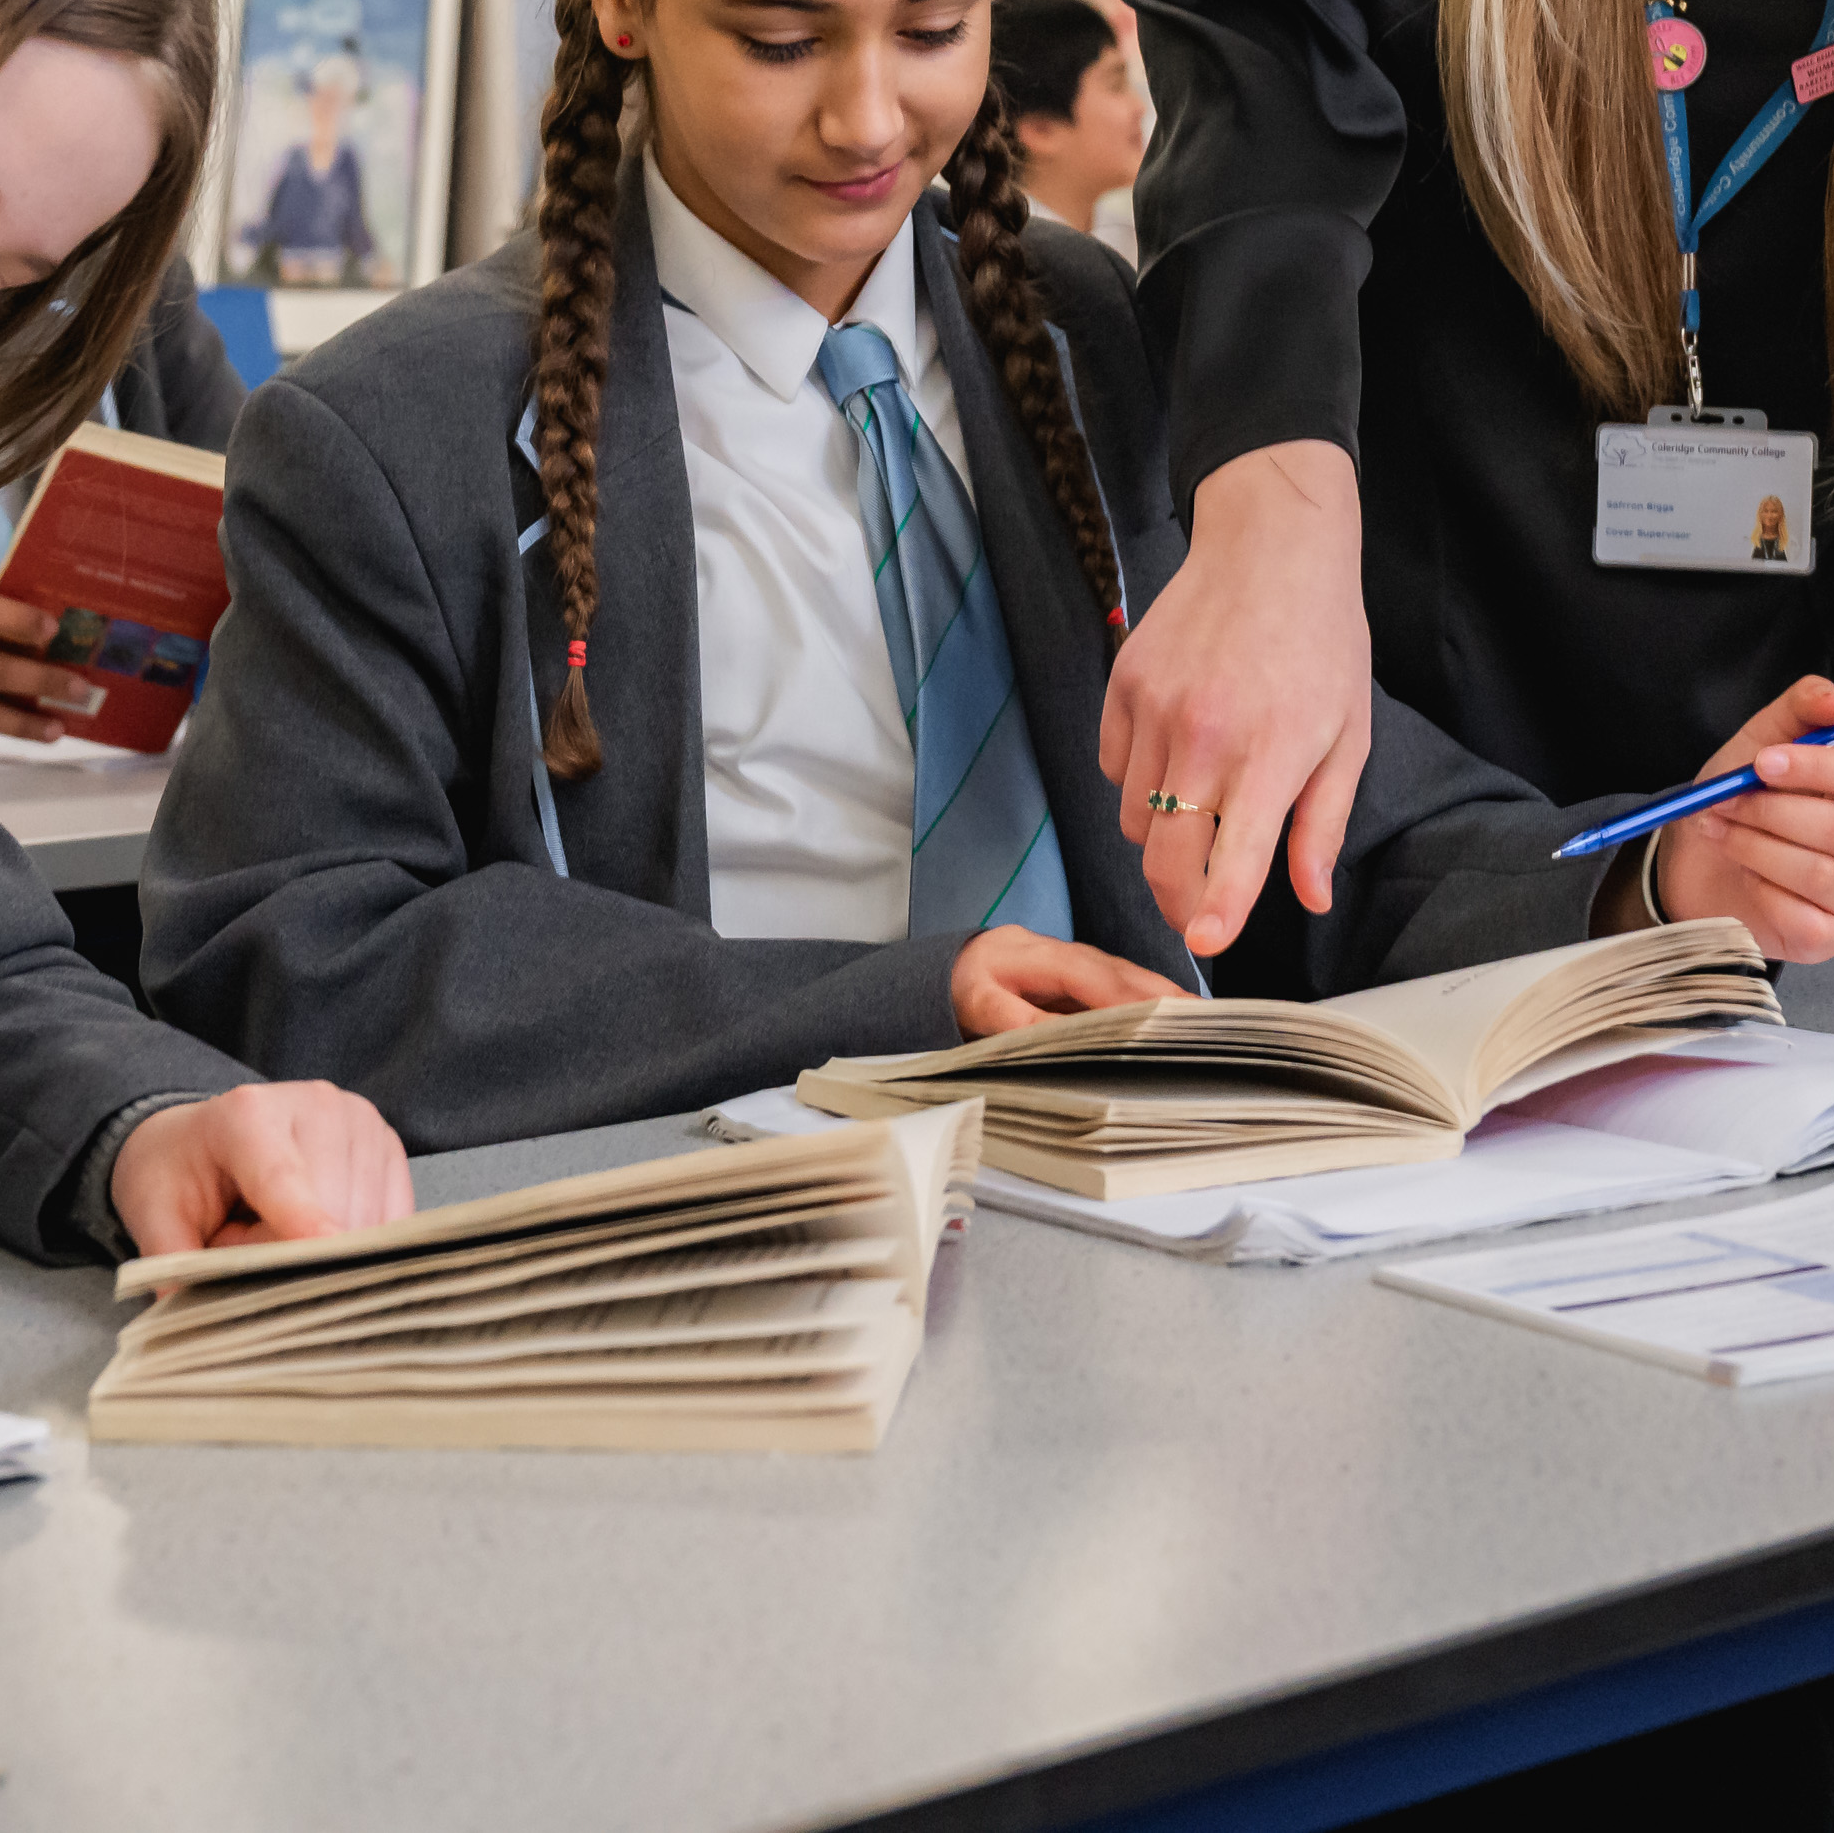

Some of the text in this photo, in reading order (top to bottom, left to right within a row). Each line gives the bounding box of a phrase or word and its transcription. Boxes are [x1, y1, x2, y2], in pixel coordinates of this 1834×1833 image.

[1729, 99, 1796, 176] Community
[1669, 136, 1686, 217] Coleridge
[1651, 442, 1787, 459] Coleridge Community College
